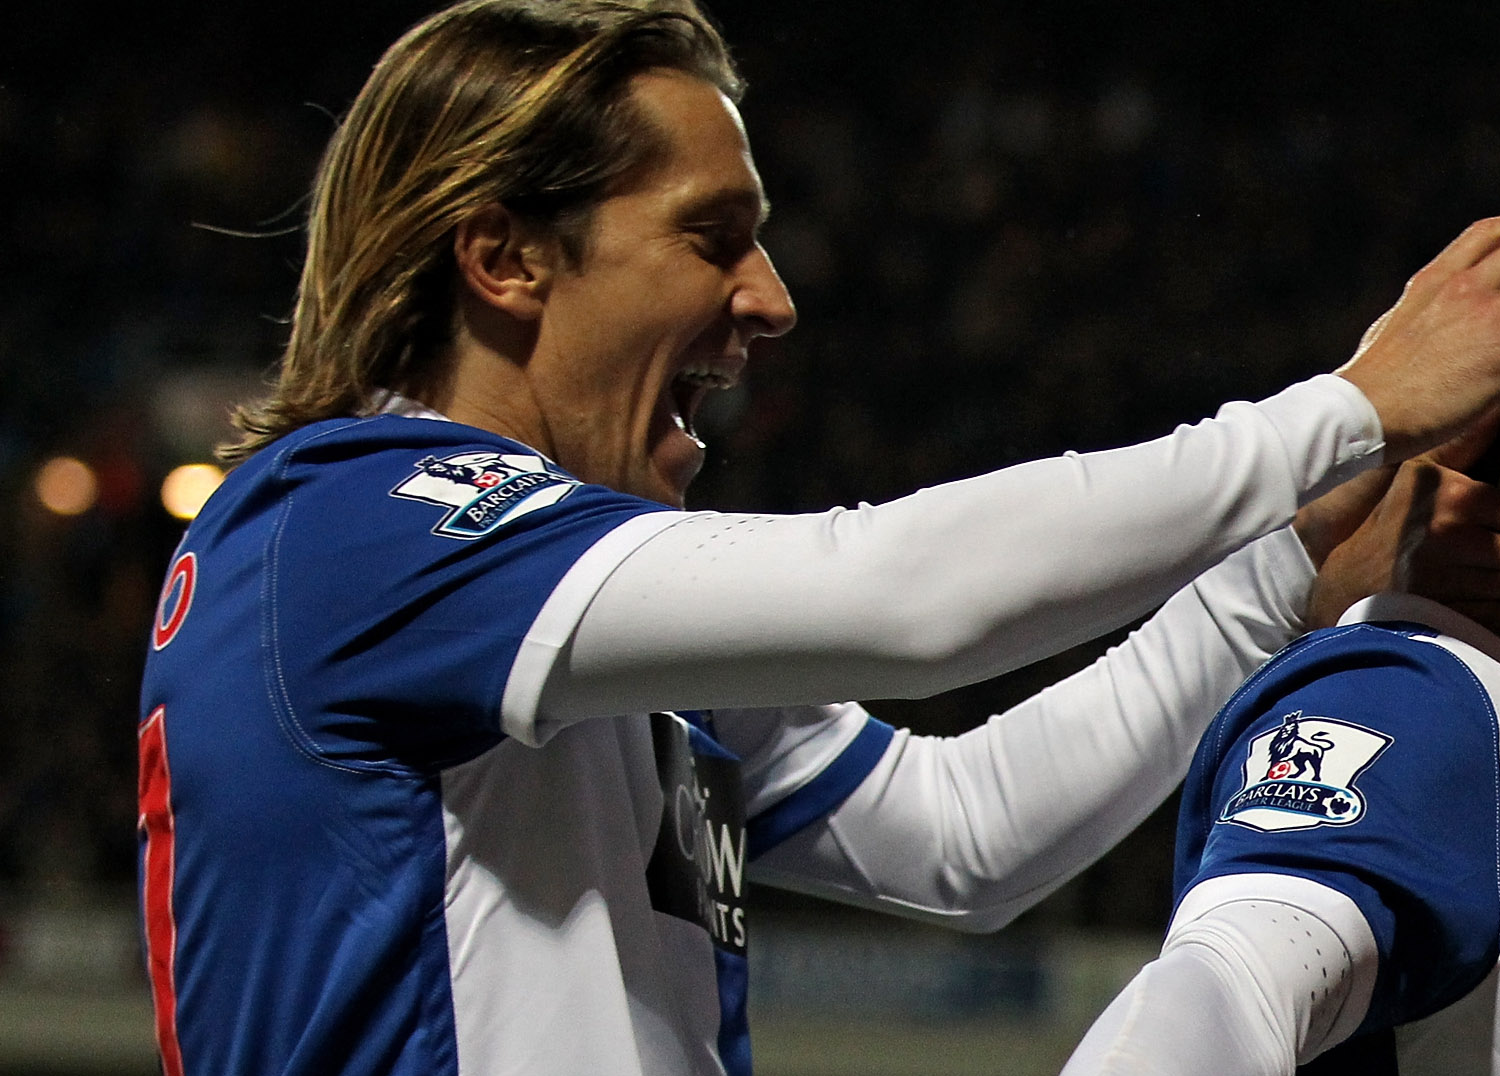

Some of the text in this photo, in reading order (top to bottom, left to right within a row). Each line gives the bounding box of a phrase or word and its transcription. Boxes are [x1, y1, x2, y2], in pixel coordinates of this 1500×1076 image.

[467, 473, 548, 523] BARCLAYS
[1235, 782, 1322, 808] BARCLAYS
[1269, 797, 1315, 812] LEAGUE
